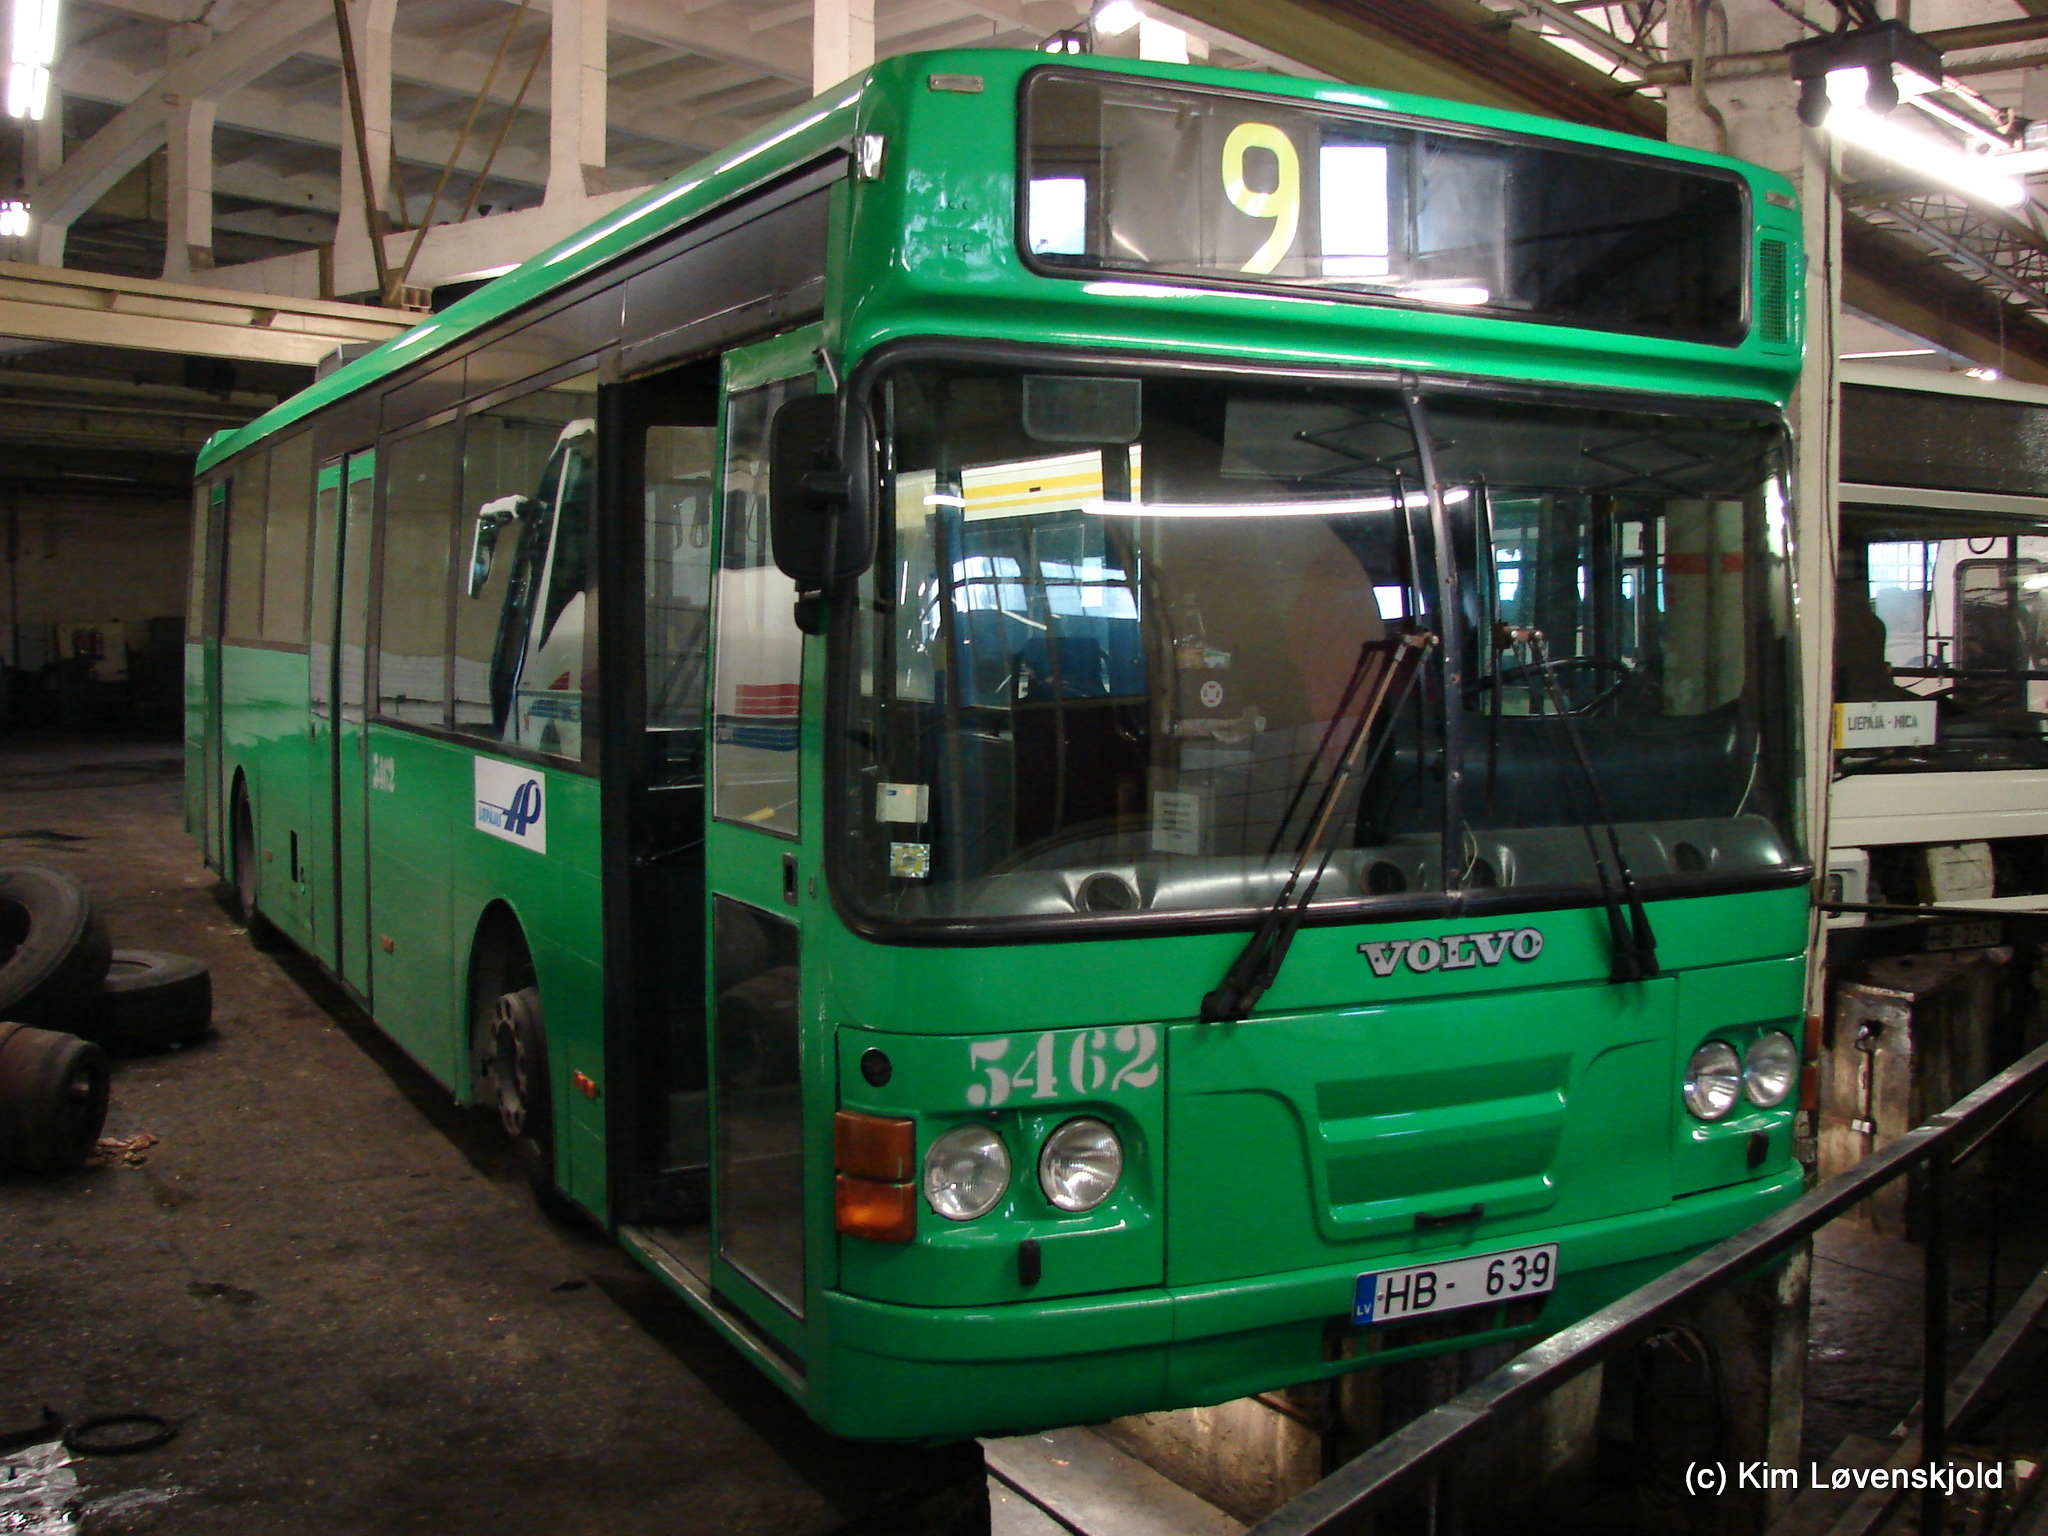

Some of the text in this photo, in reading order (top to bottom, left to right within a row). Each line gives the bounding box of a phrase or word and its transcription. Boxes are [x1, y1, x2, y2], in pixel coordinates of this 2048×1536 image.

[1222, 122, 1300, 274] 9
[1358, 927, 1544, 977] VOLVO
[966, 1024, 1159, 1107] 5462
[1486, 1251, 1550, 1296] 639
[1356, 1303, 1372, 1317] LV
